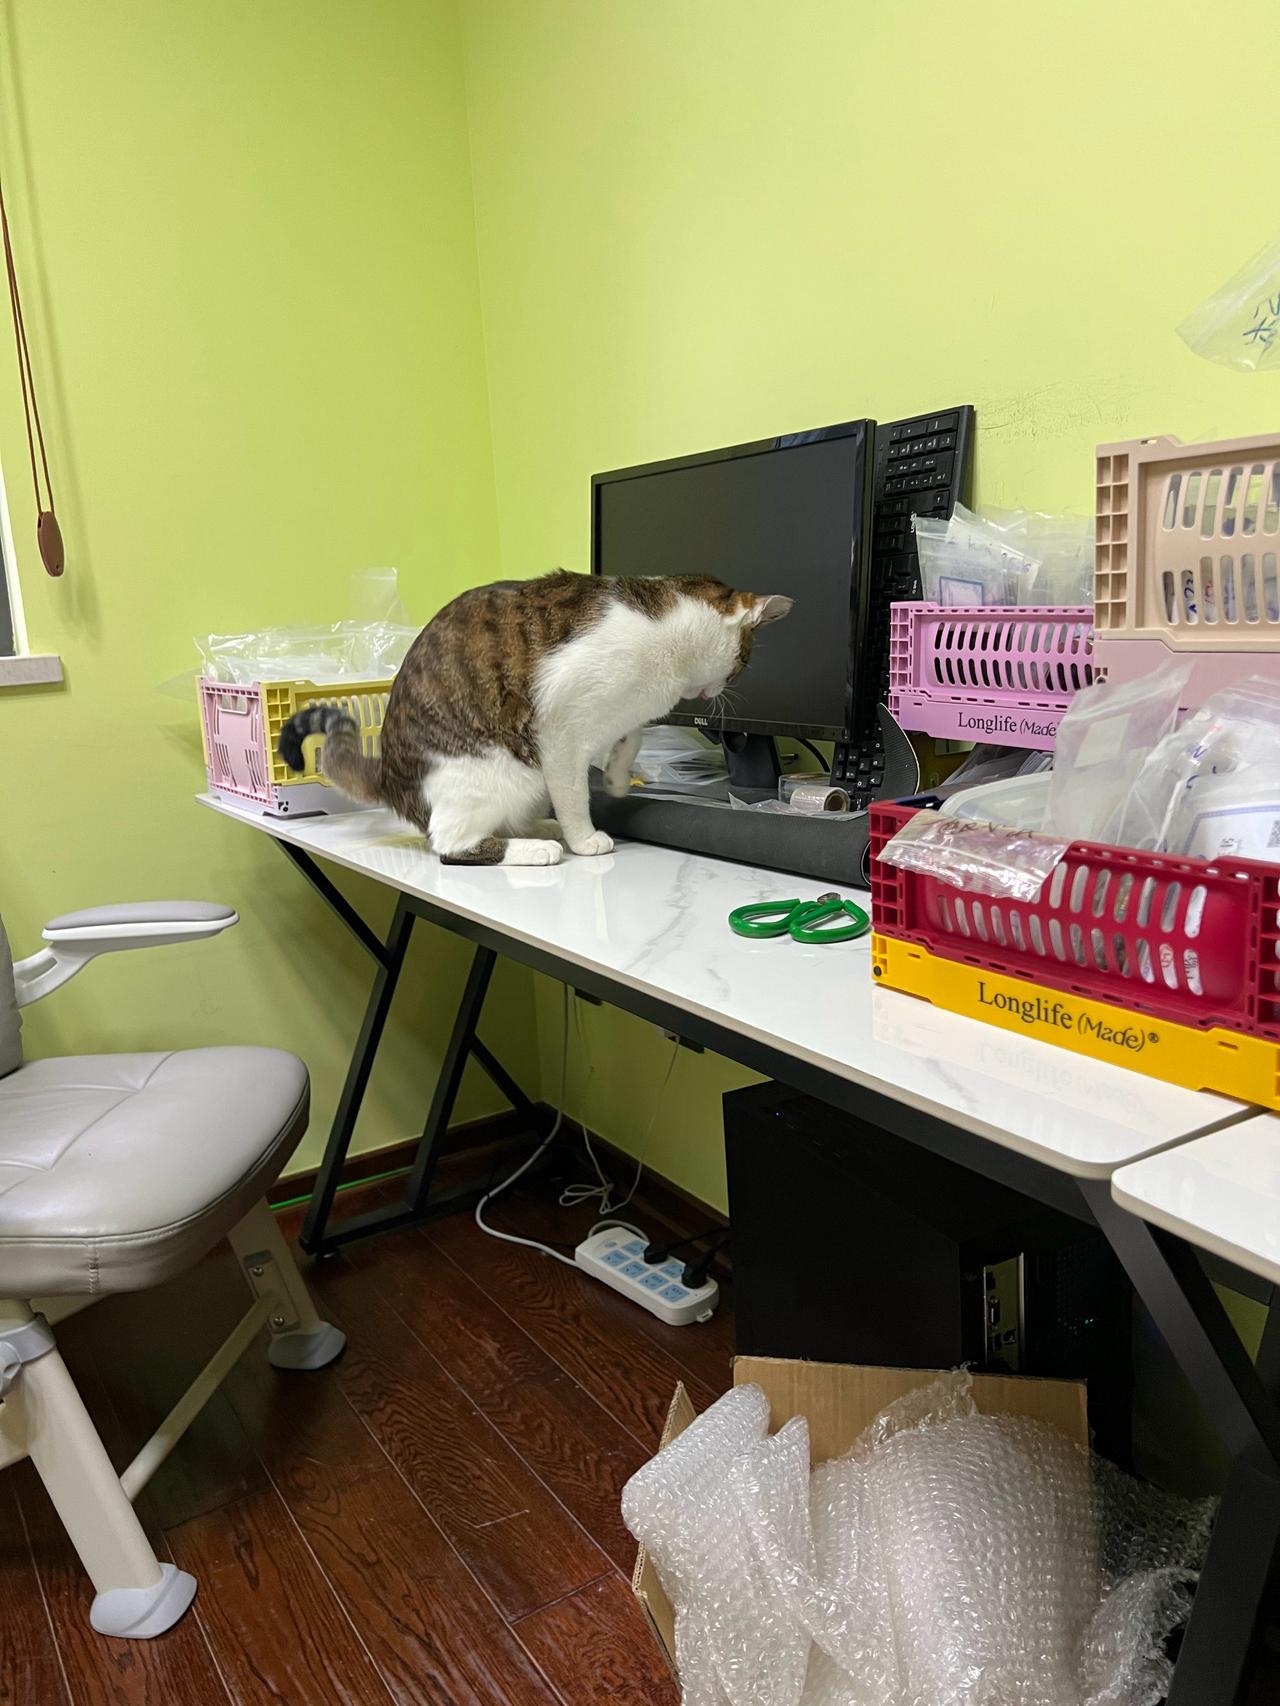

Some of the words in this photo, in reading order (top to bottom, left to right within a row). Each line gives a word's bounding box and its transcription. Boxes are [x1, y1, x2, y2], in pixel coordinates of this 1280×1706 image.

[694, 717, 708, 726] DELL
[958, 712, 1016, 734] Longlife
[1019, 718, 1060, 739] (Made
[977, 981, 1073, 1029] Longlife
